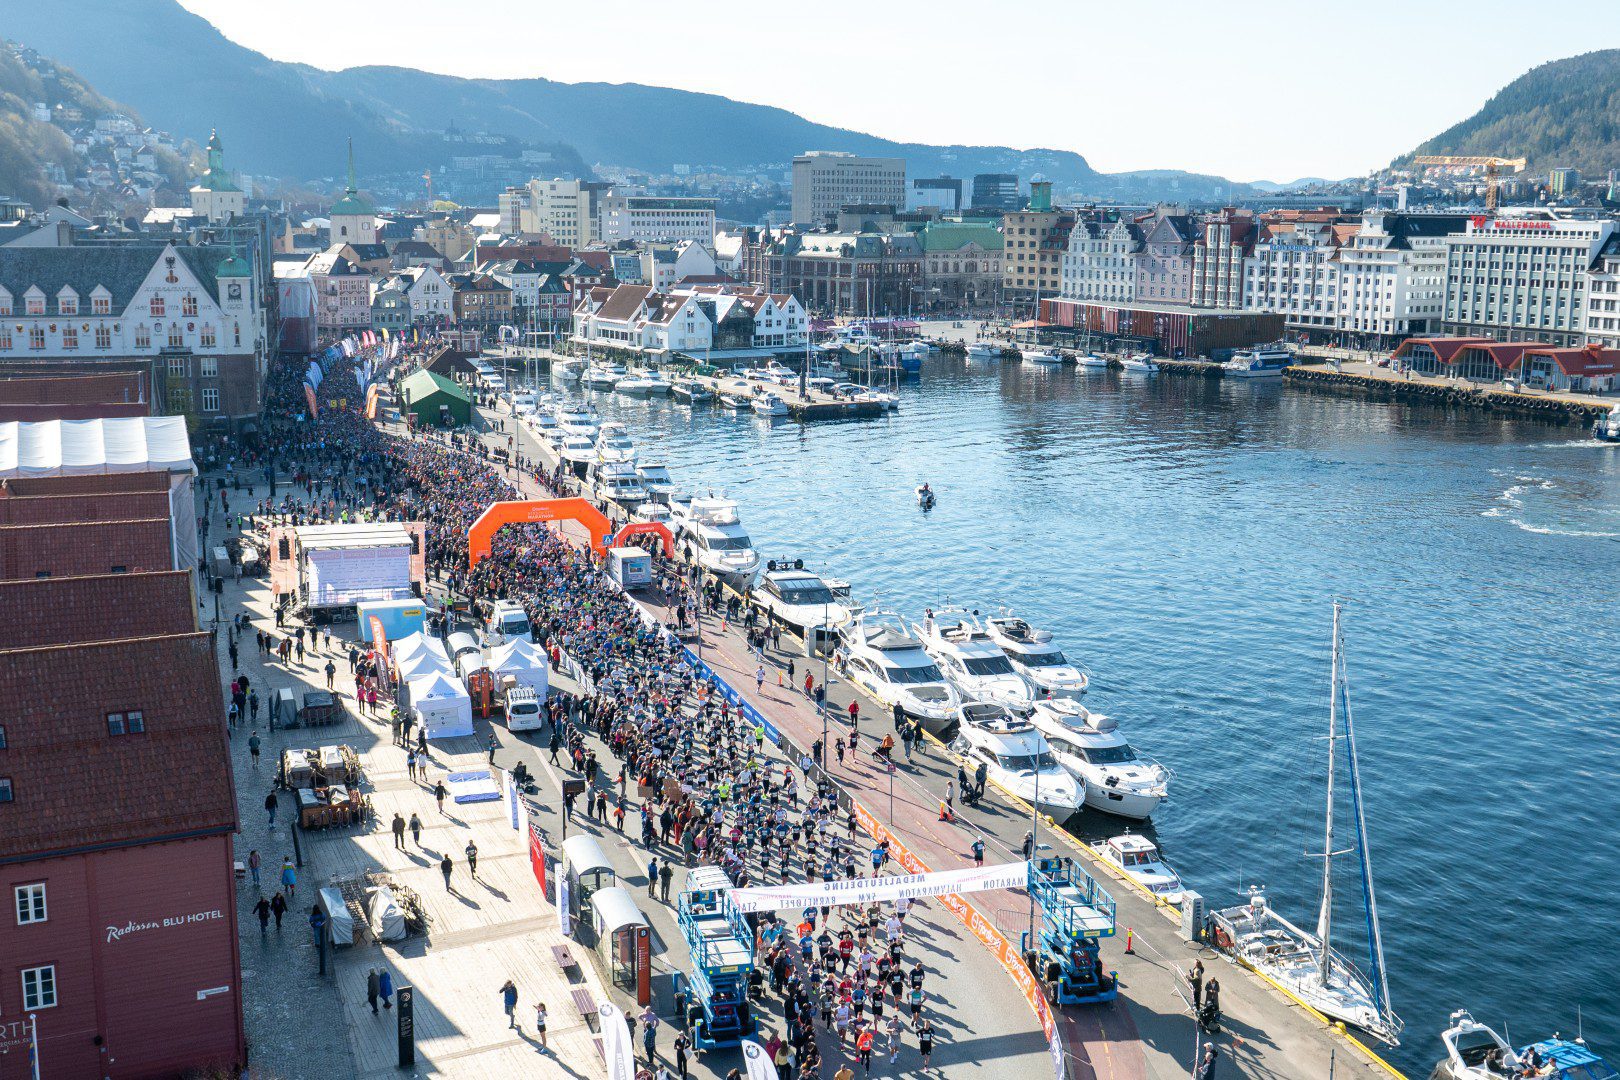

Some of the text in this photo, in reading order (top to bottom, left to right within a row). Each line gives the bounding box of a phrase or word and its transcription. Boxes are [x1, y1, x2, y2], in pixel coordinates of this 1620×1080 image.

[1494, 221, 1551, 229] WALLENDAHL
[106, 910, 223, 943] Radisson BLU HOTEL
